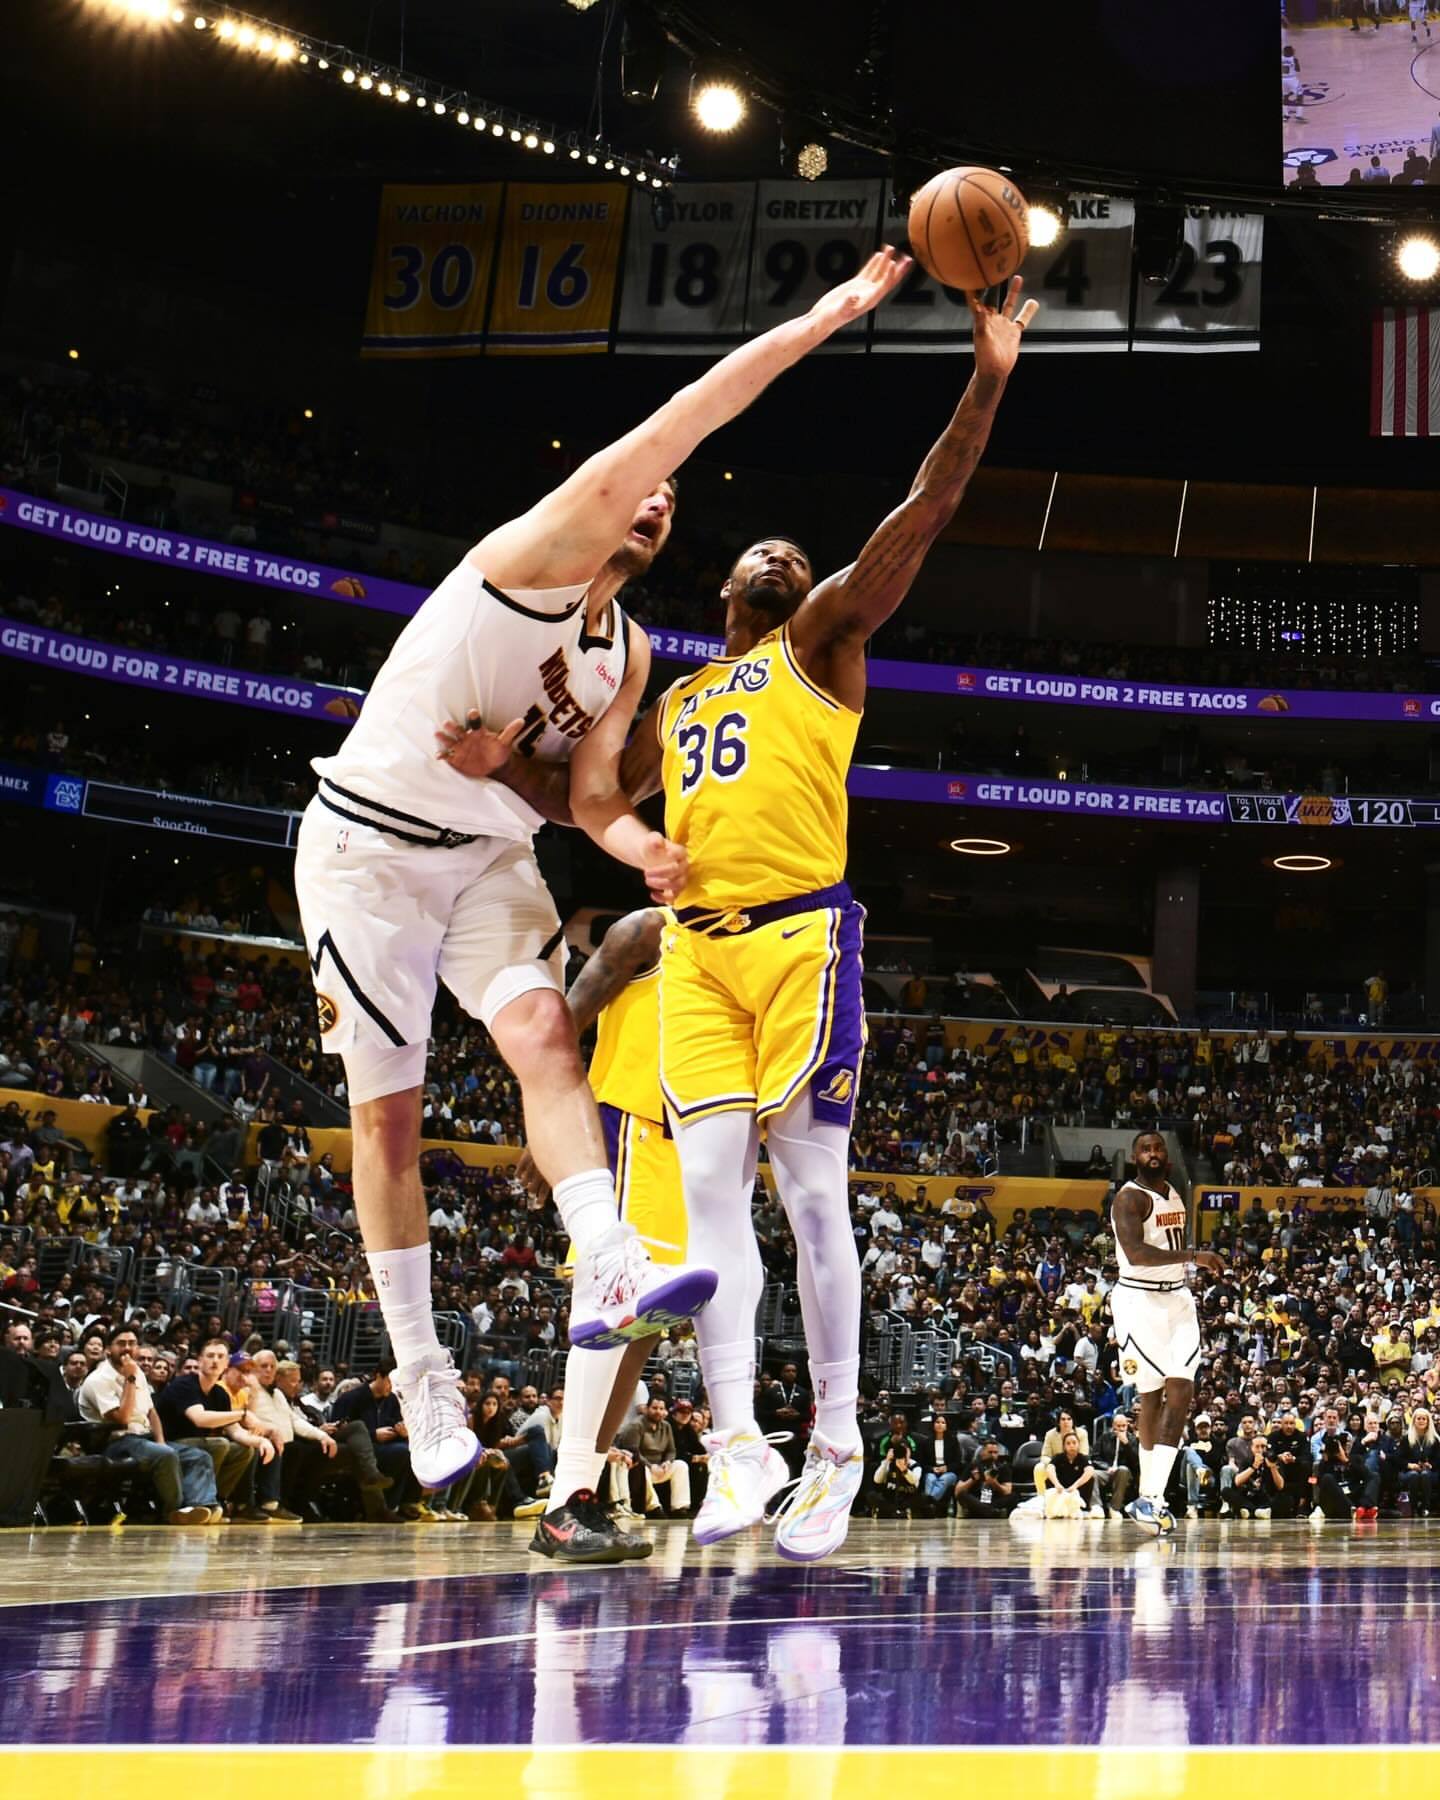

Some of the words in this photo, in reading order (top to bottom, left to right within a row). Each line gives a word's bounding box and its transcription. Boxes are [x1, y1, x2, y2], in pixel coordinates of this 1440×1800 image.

[396, 203, 484, 223] VACHON
[519, 201, 610, 223] DIONNE
[671, 202, 733, 222] YLOR
[766, 199, 868, 220] GRETZKY
[383, 241, 475, 312] 30
[516, 241, 591, 310] 16
[647, 242, 718, 307] 18
[766, 239, 859, 307] 99
[1044, 239, 1090, 306] 4
[1155, 240, 1243, 307] 23
[17, 502, 60, 529] GET
[62, 514, 122, 546] LOUD
[126, 532, 172, 558] FOR
[176, 542, 191, 562] 2
[194, 546, 249, 574] FREE
[254, 558, 321, 589] TACOS
[666, 636, 678, 653] 2
[1, 628, 45, 655] GET
[47, 640, 108, 670] LOUD
[112, 655, 159, 681] FOR
[163, 665, 179, 684] 2
[183, 669, 240, 696] FREE
[245, 680, 313, 710] TACOS
[985, 675, 1022, 694] GET
[1025, 678, 1077, 698] LOUD
[1080, 683, 1119, 702] FOR
[1123, 687, 1134, 703] 2
[1138, 689, 1184, 708] FREE
[1188, 693, 1248, 710] TACOS
[678, 712, 747, 792] 36
[977, 783, 1014, 801] GET
[1018, 787, 1070, 805] LOUD
[1075, 791, 1114, 809] FOR
[1118, 795, 1129, 810] 2
[1134, 795, 1181, 814] FREE
[1240, 806, 1250, 819] 2
[1266, 807, 1276, 820] 0
[1259, 798, 1281, 806] FOULS
[1357, 801, 1404, 823] 120
[1208, 1194, 1232, 1208] 11
